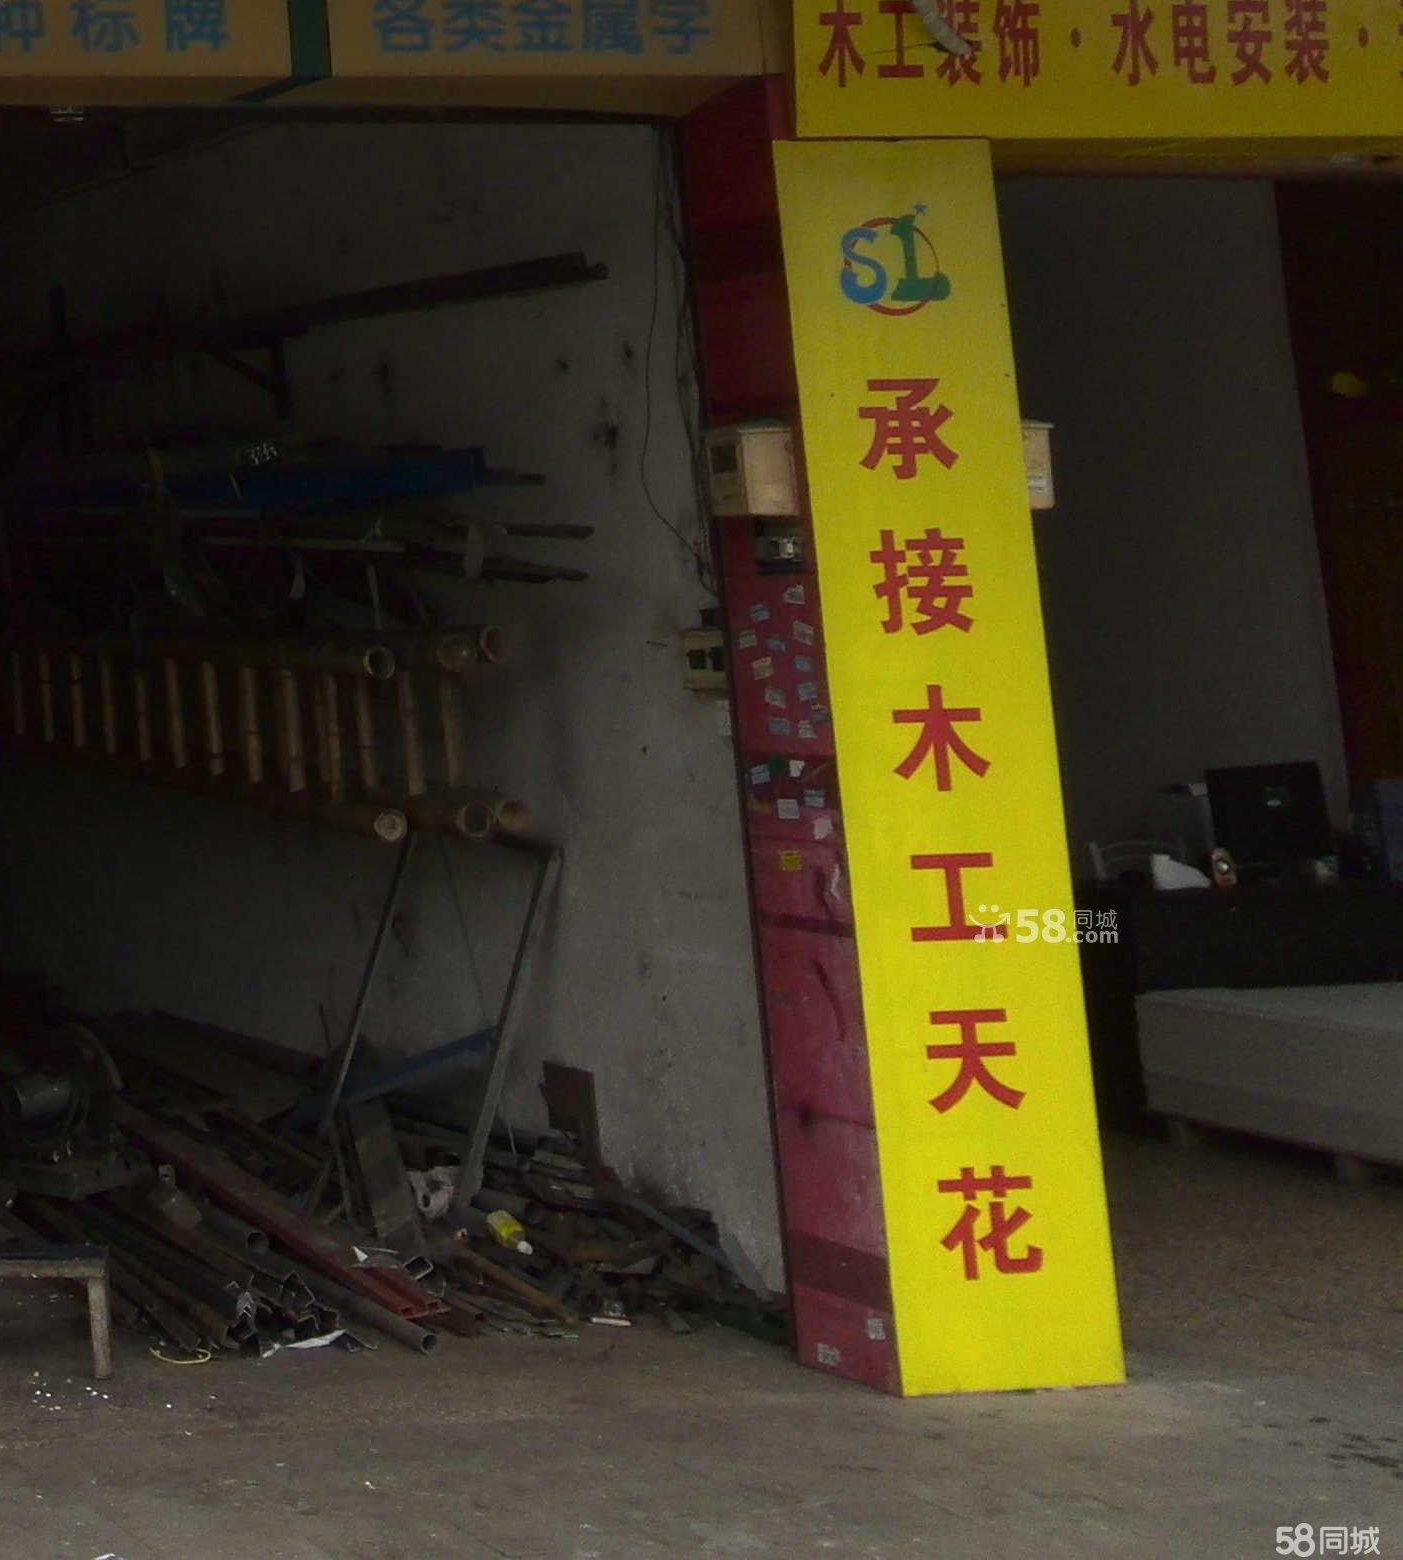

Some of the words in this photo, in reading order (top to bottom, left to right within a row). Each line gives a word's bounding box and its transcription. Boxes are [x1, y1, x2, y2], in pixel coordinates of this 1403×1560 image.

[858, 377, 1044, 1281] 承接木工天花
